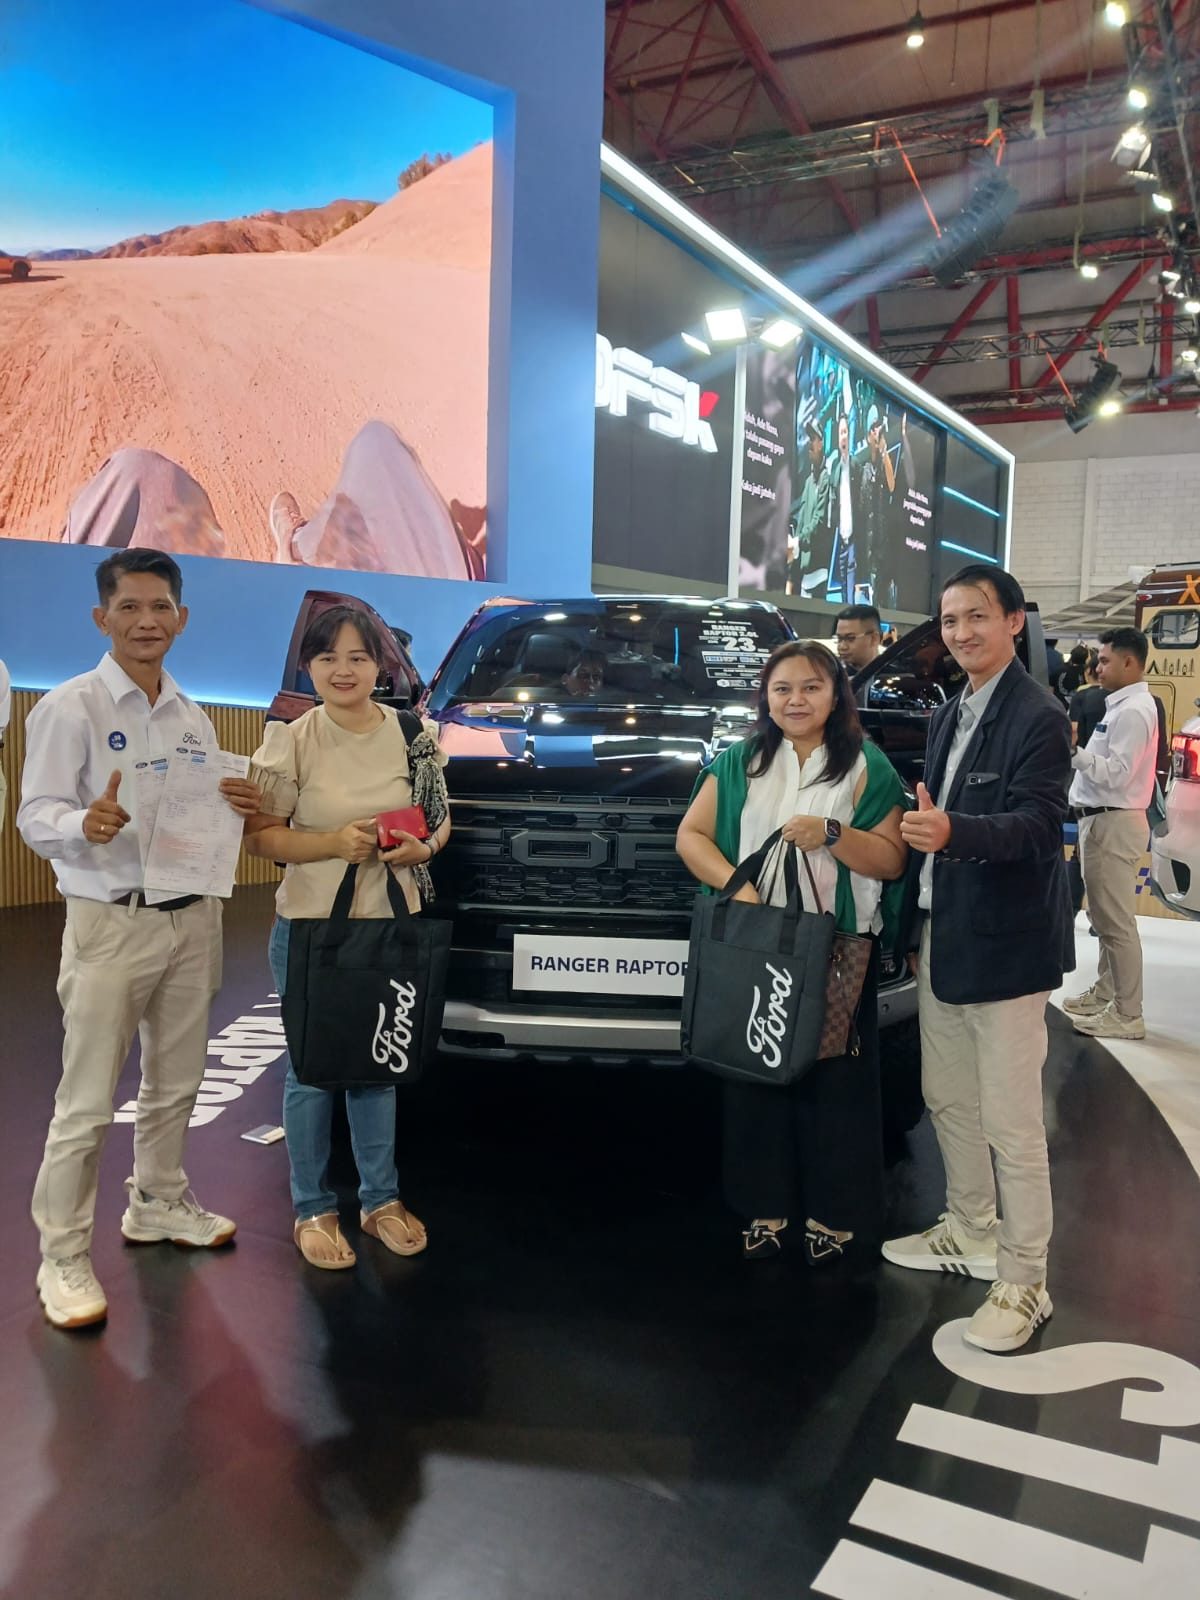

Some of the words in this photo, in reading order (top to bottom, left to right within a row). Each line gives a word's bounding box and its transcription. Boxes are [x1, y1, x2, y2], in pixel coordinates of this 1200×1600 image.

[721, 637, 756, 652] 23
[531, 955, 609, 974] RANGER
[371, 978, 417, 1074] Ford
[745, 962, 793, 1069] Ford
